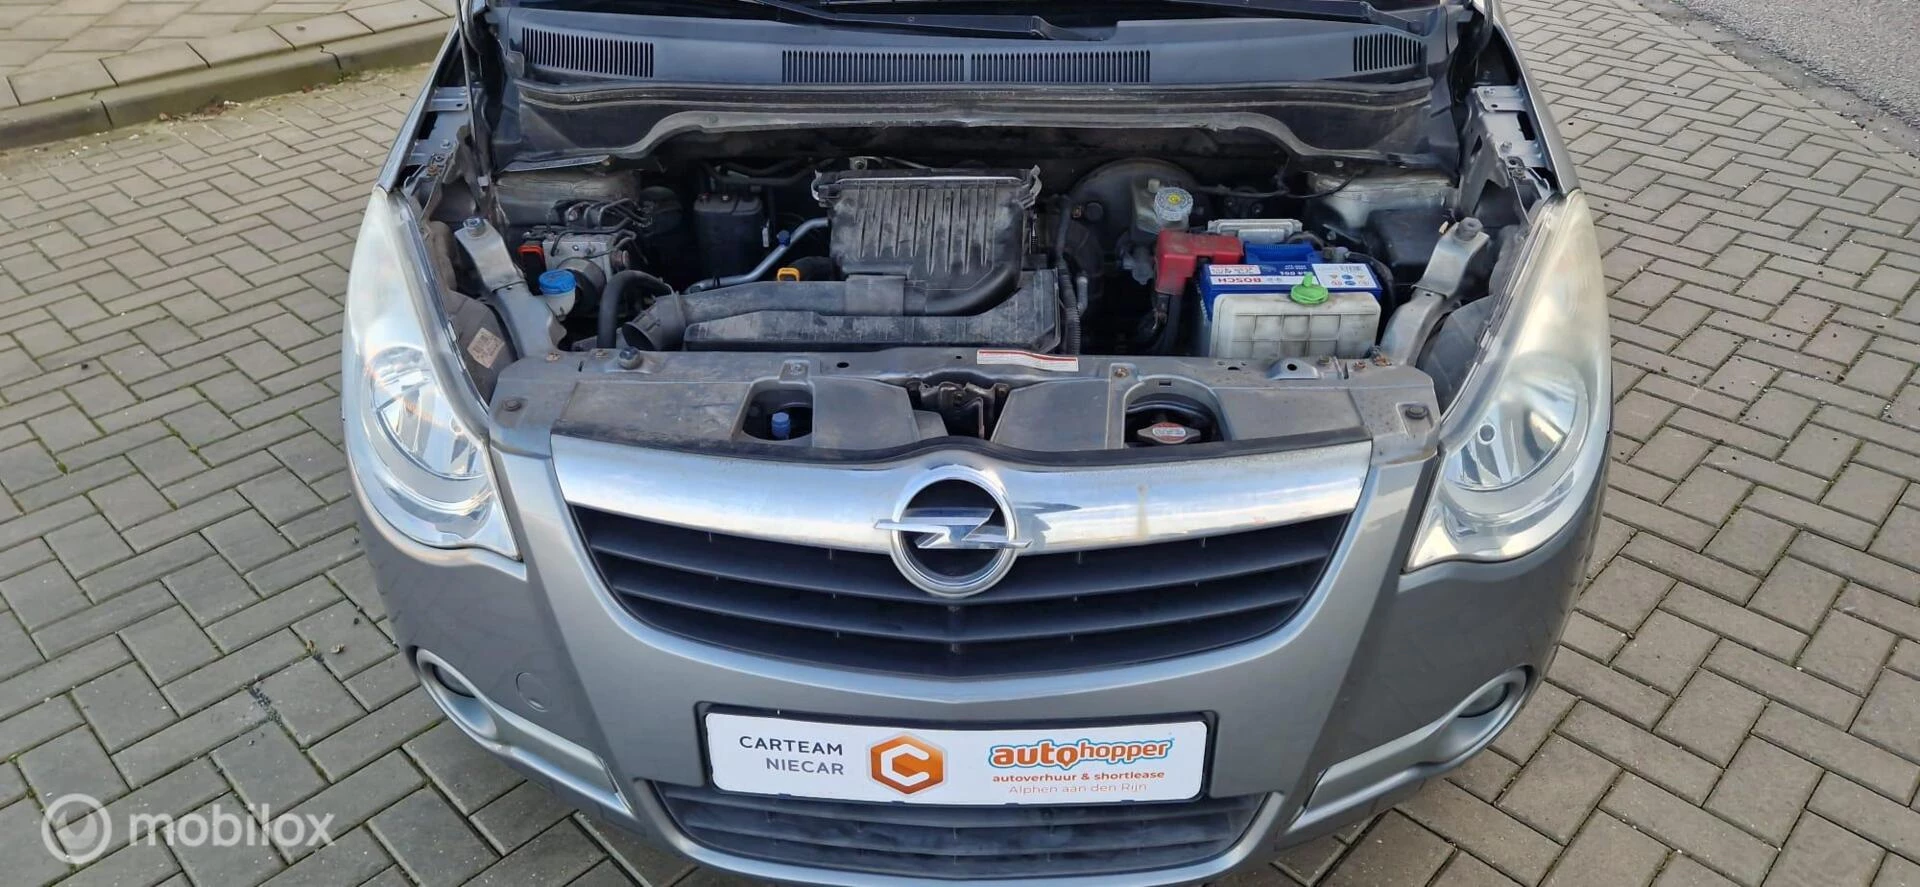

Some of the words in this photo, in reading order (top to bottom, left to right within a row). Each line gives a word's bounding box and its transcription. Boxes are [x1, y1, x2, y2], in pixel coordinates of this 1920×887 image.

[740, 735, 843, 756] CARTEAM
[991, 741, 1170, 767] autohopper
[766, 757, 844, 775] NIECAR
[992, 773, 1077, 783] autoverhuur
[1080, 772, 1090, 781] &
[1094, 771, 1165, 782] shortlease
[1009, 784, 1058, 796] Alphen
[1063, 785, 1088, 793] aan
[1090, 783, 1117, 792] den
[1121, 783, 1148, 793] Rijn
